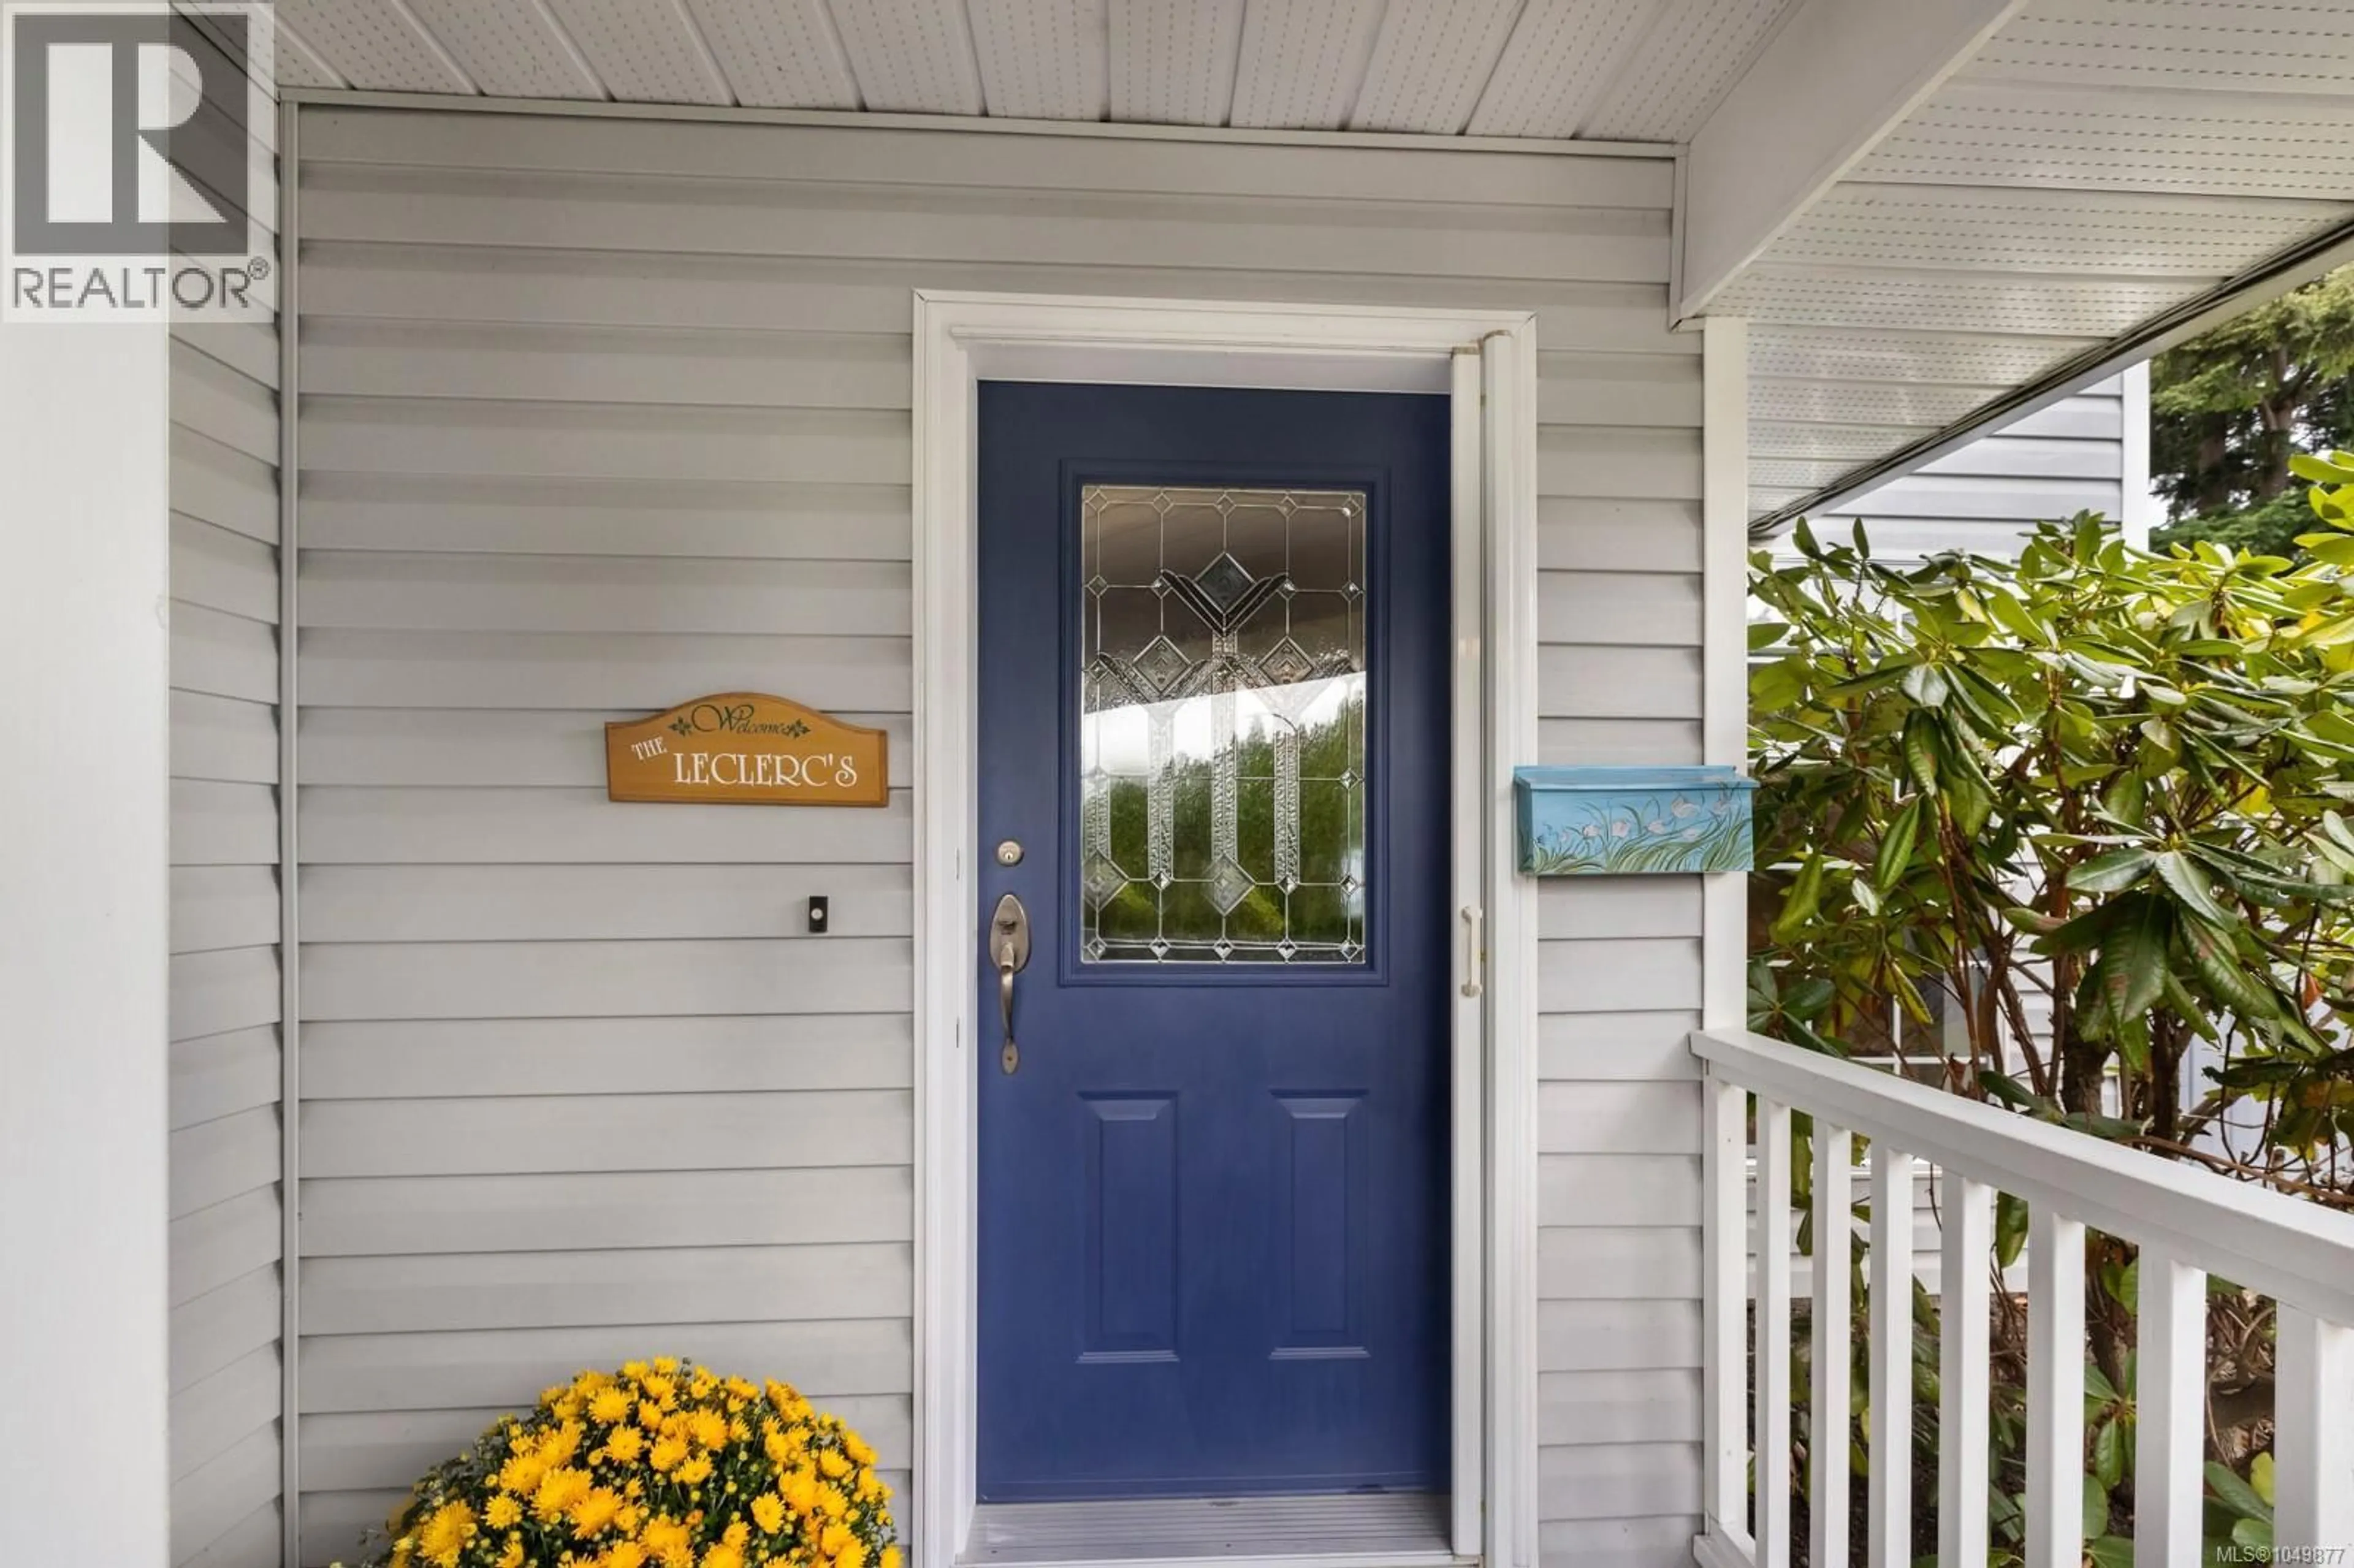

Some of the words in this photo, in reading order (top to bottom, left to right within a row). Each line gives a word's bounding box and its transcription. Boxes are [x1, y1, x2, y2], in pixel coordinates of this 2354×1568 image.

[691, 704, 792, 734] Welcome
[631, 736, 668, 761] THE
[673, 752, 858, 788] LECLERC'S
